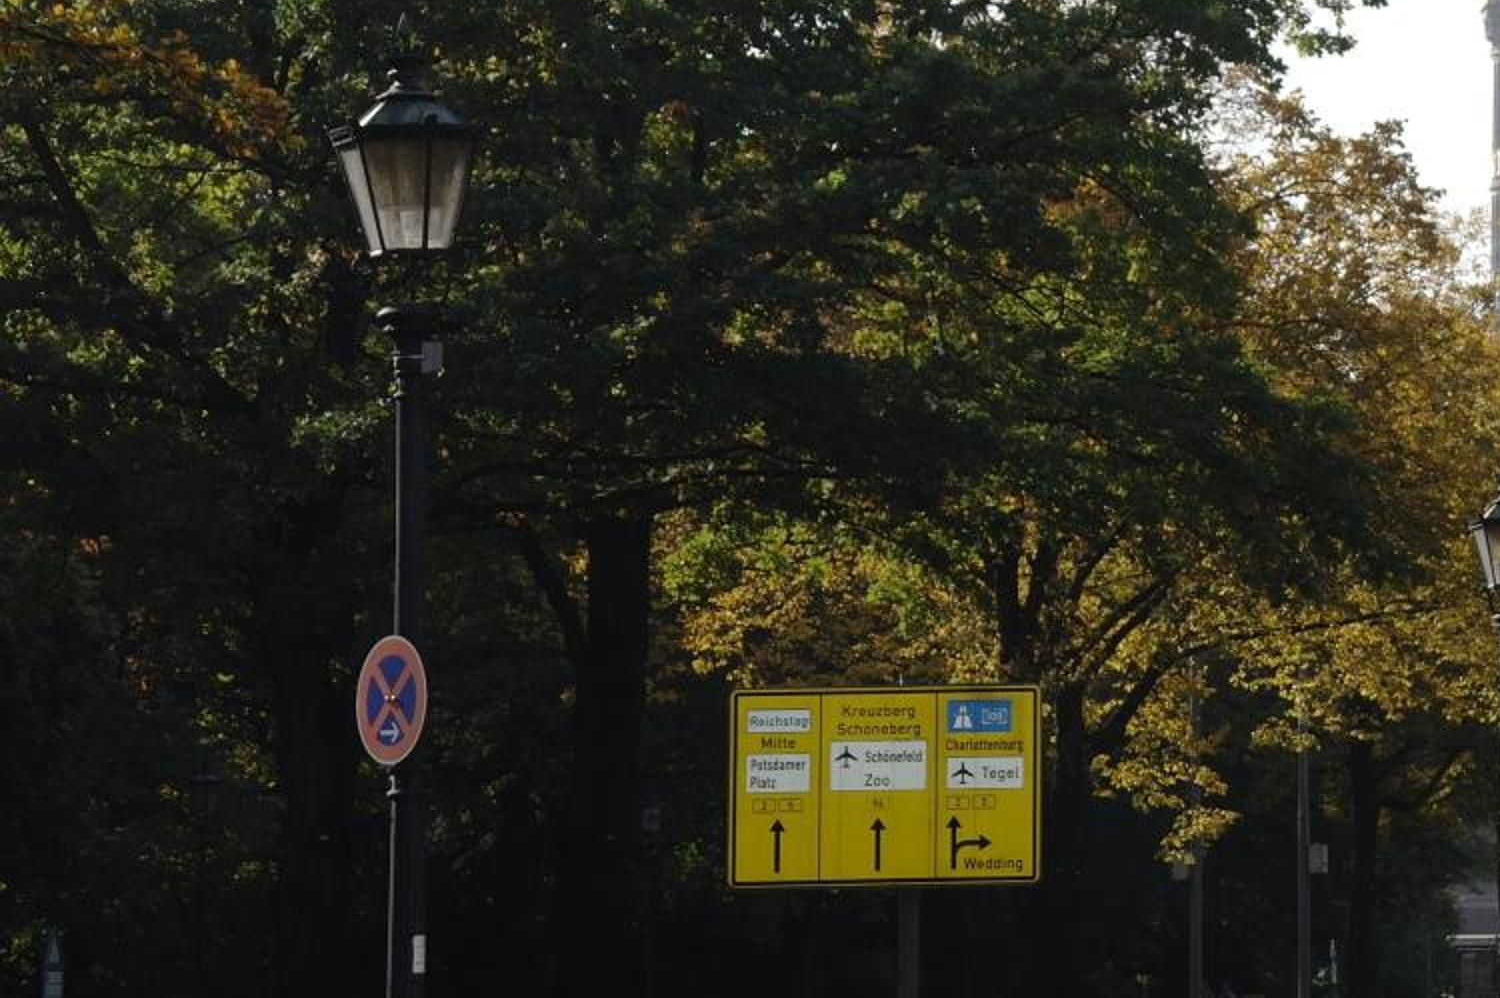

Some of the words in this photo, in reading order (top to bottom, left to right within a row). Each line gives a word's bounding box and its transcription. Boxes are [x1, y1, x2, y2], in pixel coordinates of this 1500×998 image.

[842, 705, 916, 719] Kreuzberg
[750, 715, 810, 729] Reichstag
[761, 737, 797, 749] Mitte
[945, 738, 1025, 753] Charlottenburg
[750, 758, 806, 771] Potsdamer
[864, 773, 891, 787] Zoo
[982, 766, 1020, 782] Tegel
[750, 775, 777, 789] Platz
[964, 857, 1023, 873] Wedding
